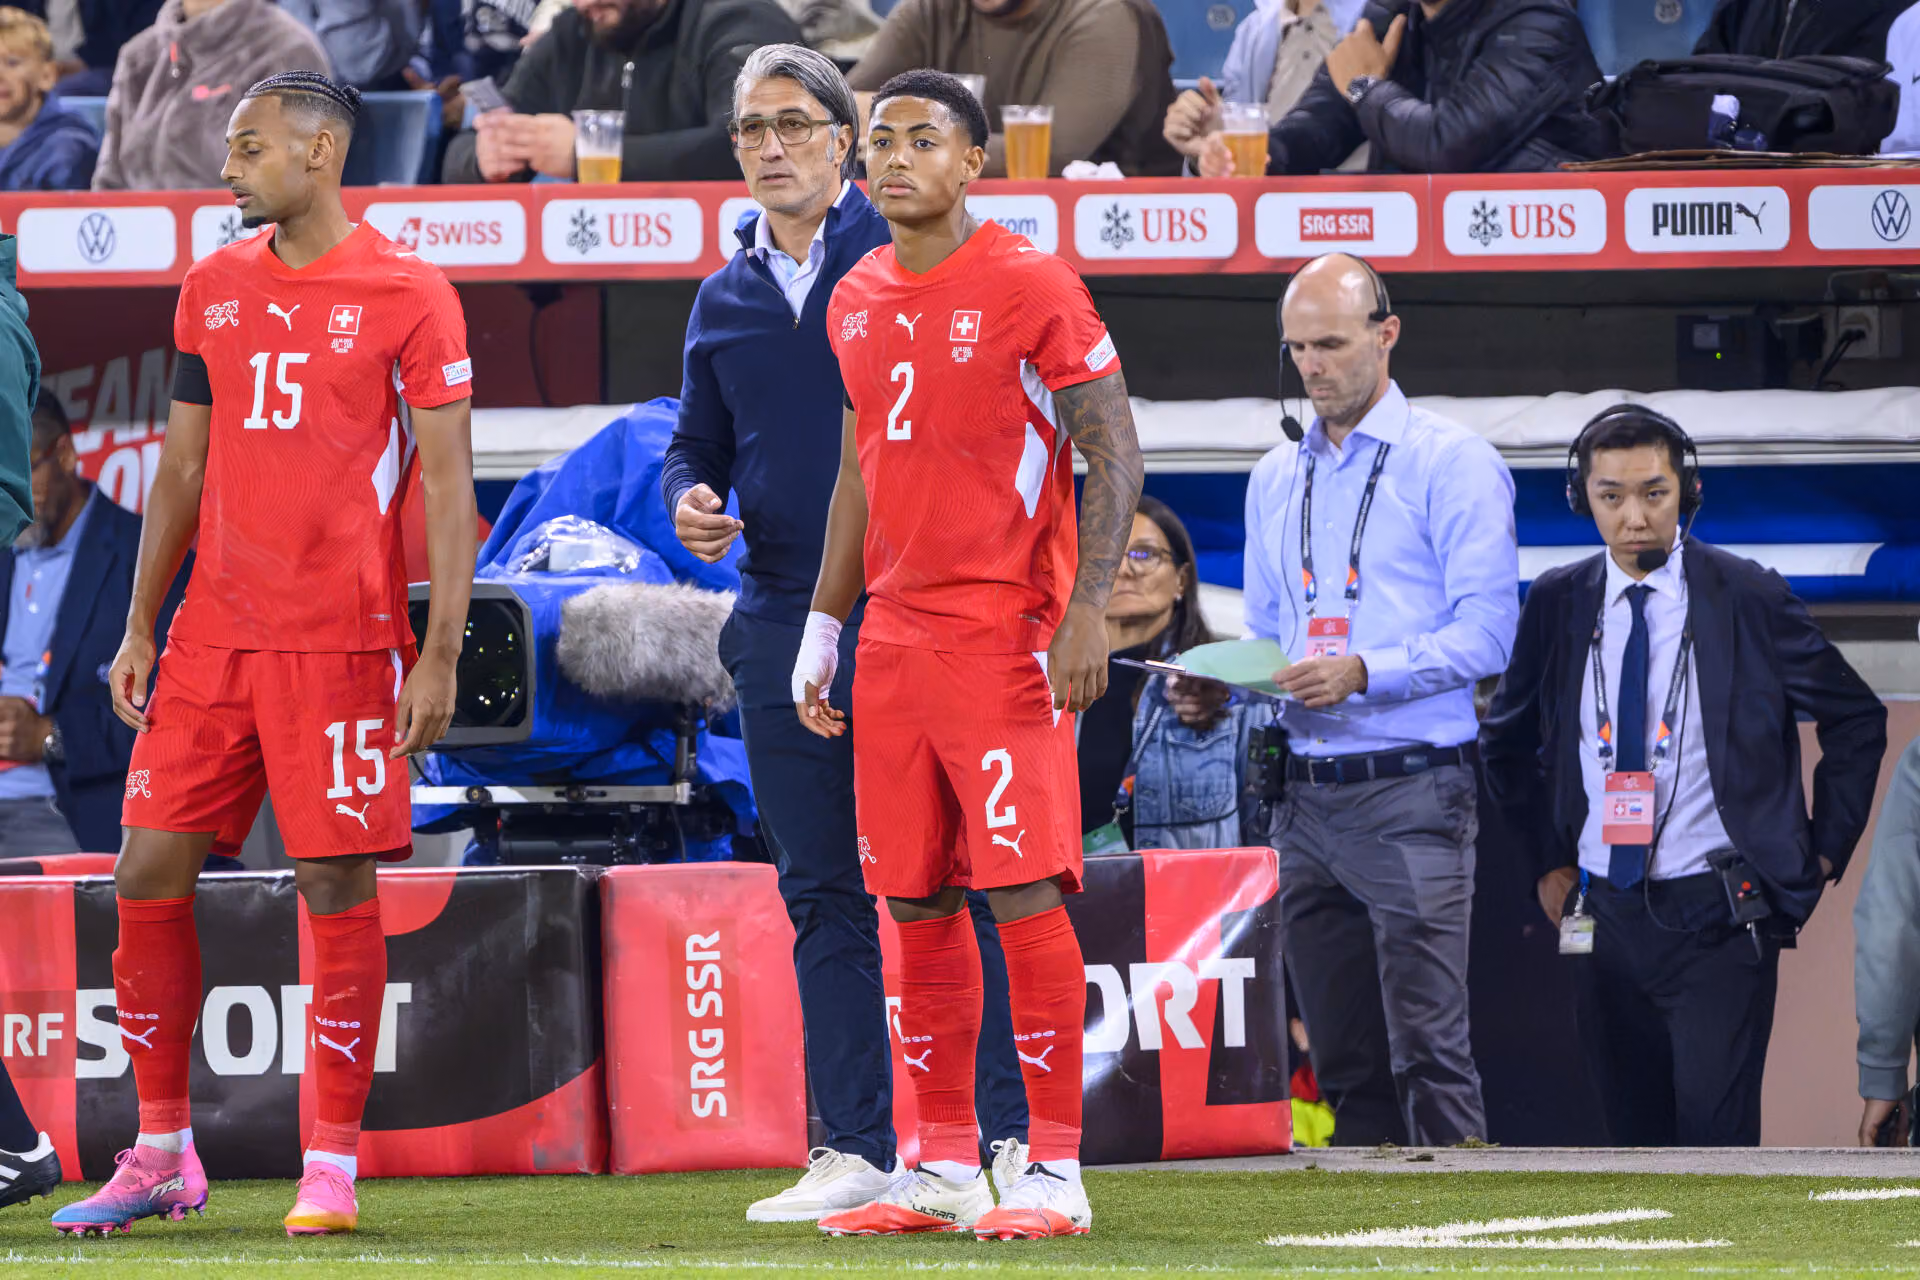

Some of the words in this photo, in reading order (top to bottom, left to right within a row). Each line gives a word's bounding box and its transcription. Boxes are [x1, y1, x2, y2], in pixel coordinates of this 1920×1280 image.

[426, 220, 502, 247] SWISS
[607, 212, 673, 248] UBS
[1140, 207, 1208, 243] UBS
[1302, 213, 1336, 235] SRG
[1338, 213, 1371, 235] SSR
[1508, 203, 1577, 240] UBS
[1652, 201, 1733, 237] PUMA
[243, 351, 310, 430] 15
[887, 361, 914, 441] 2
[324, 718, 387, 799] 15
[981, 748, 1017, 829] 2
[686, 930, 723, 1018] SSR
[688, 1028, 727, 1118] SRG
[912, 1202, 957, 1222] ULTRA
